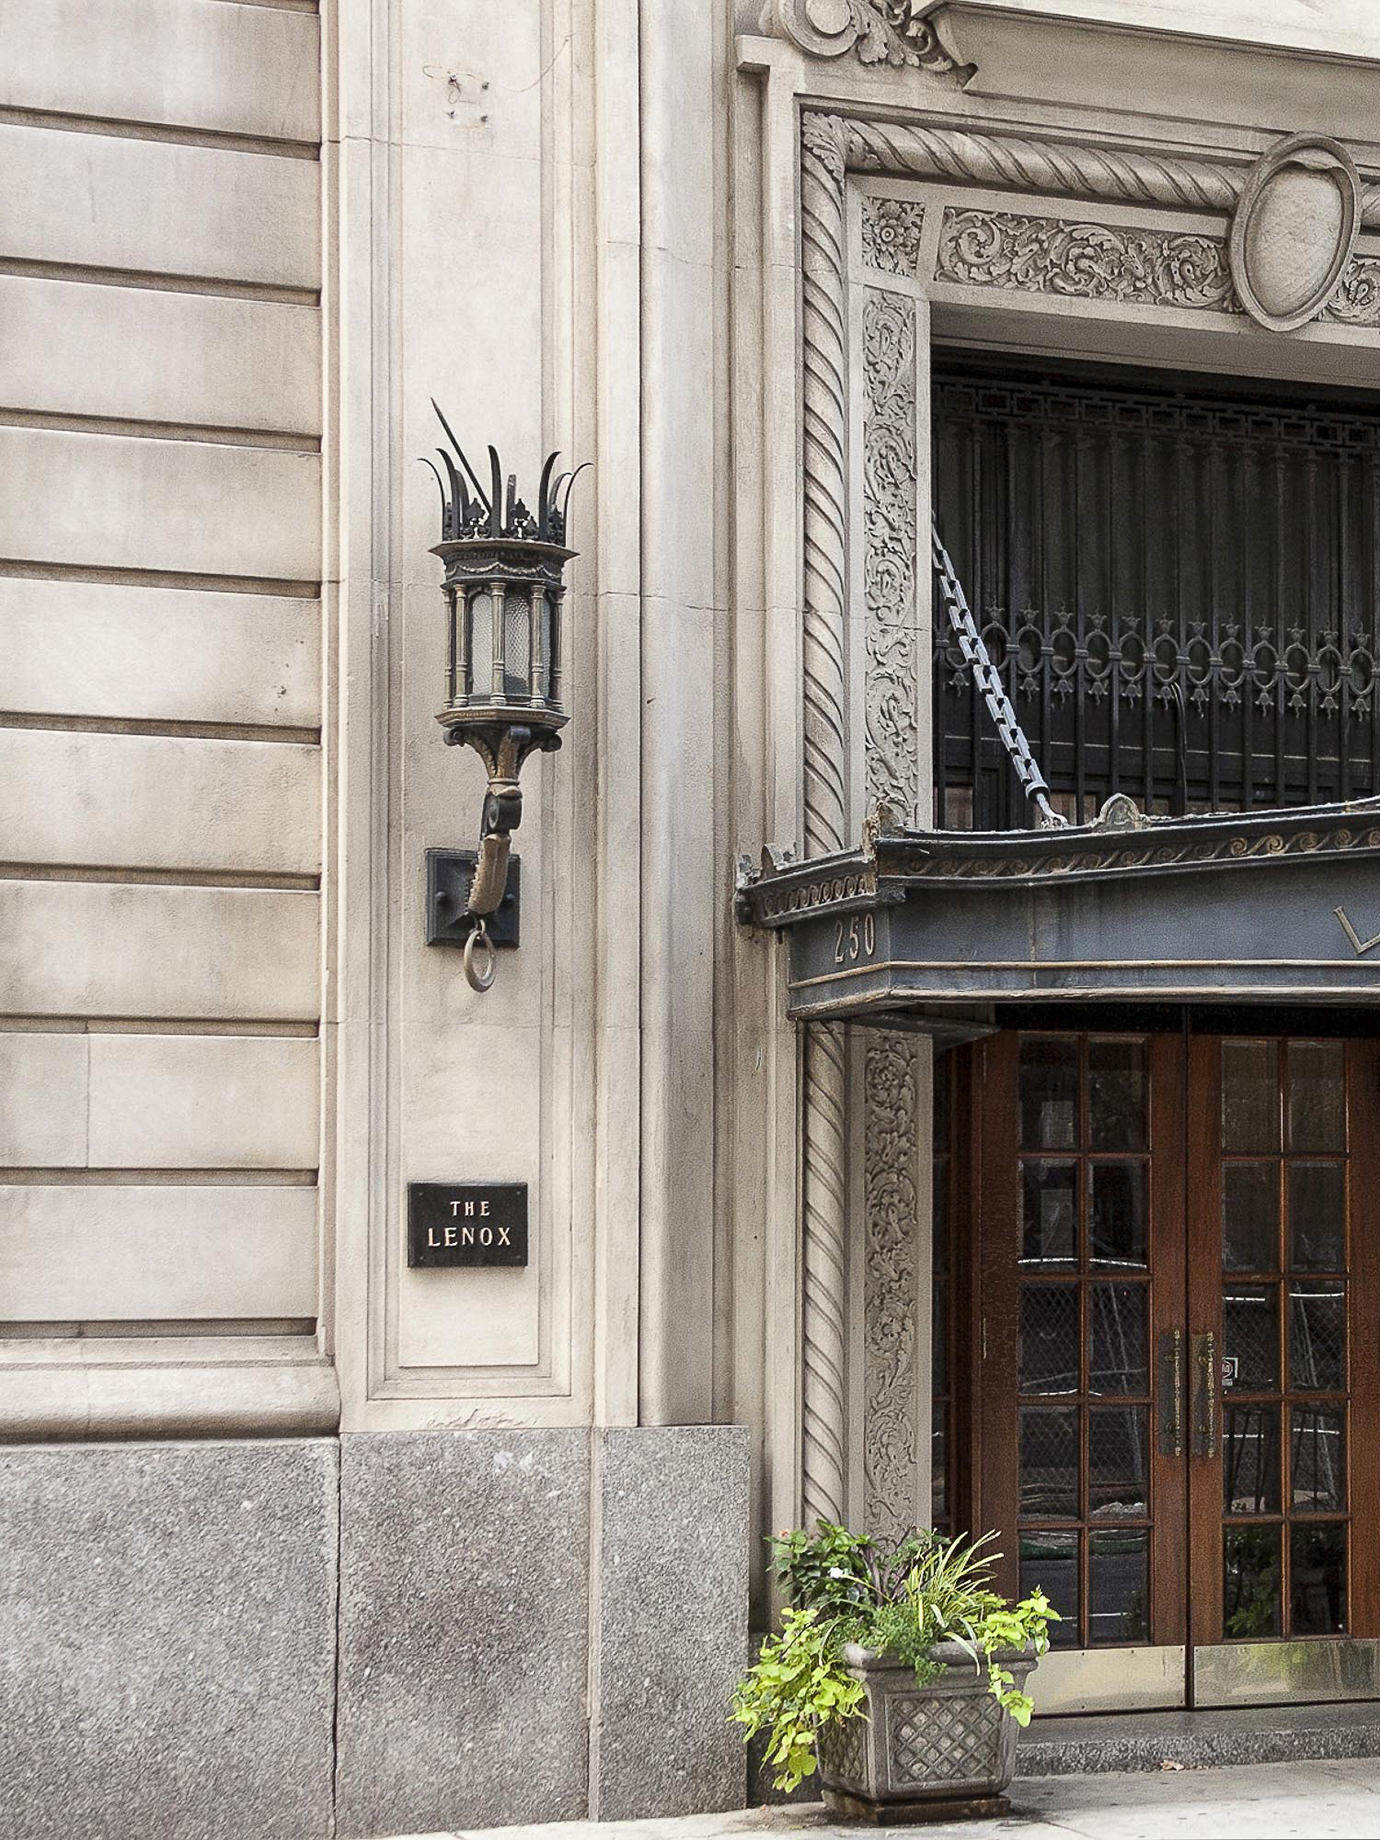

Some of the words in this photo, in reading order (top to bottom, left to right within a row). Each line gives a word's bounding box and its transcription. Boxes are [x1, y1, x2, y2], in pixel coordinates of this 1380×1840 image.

[834, 912, 875, 963] 250
[450, 1201, 490, 1216] THE
[427, 1227, 511, 1247] LENOX
